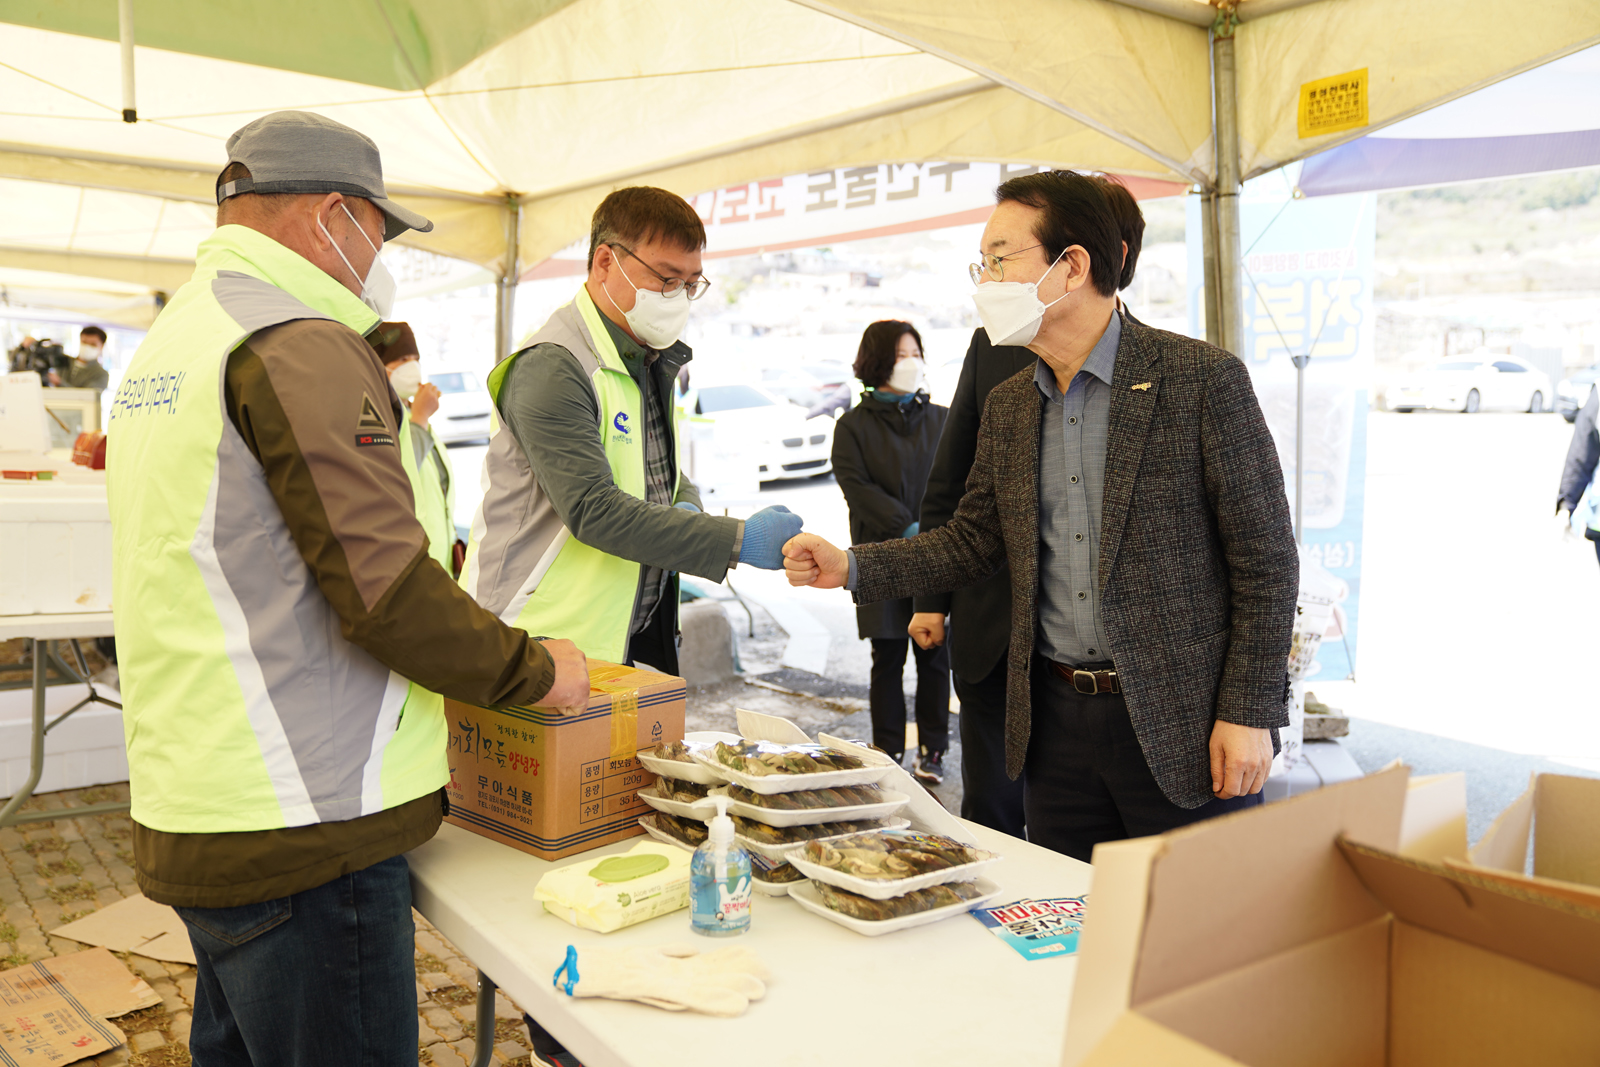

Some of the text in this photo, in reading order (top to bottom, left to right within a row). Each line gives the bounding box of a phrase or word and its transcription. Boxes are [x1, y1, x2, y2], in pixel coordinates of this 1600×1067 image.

[585, 764, 600, 778] 품명
[584, 774, 642, 798] 용량 120g
[584, 803, 600, 817] 수량
[619, 795, 631, 806] 35
[633, 889, 648, 898] Aloe
[648, 884, 662, 894] vera
